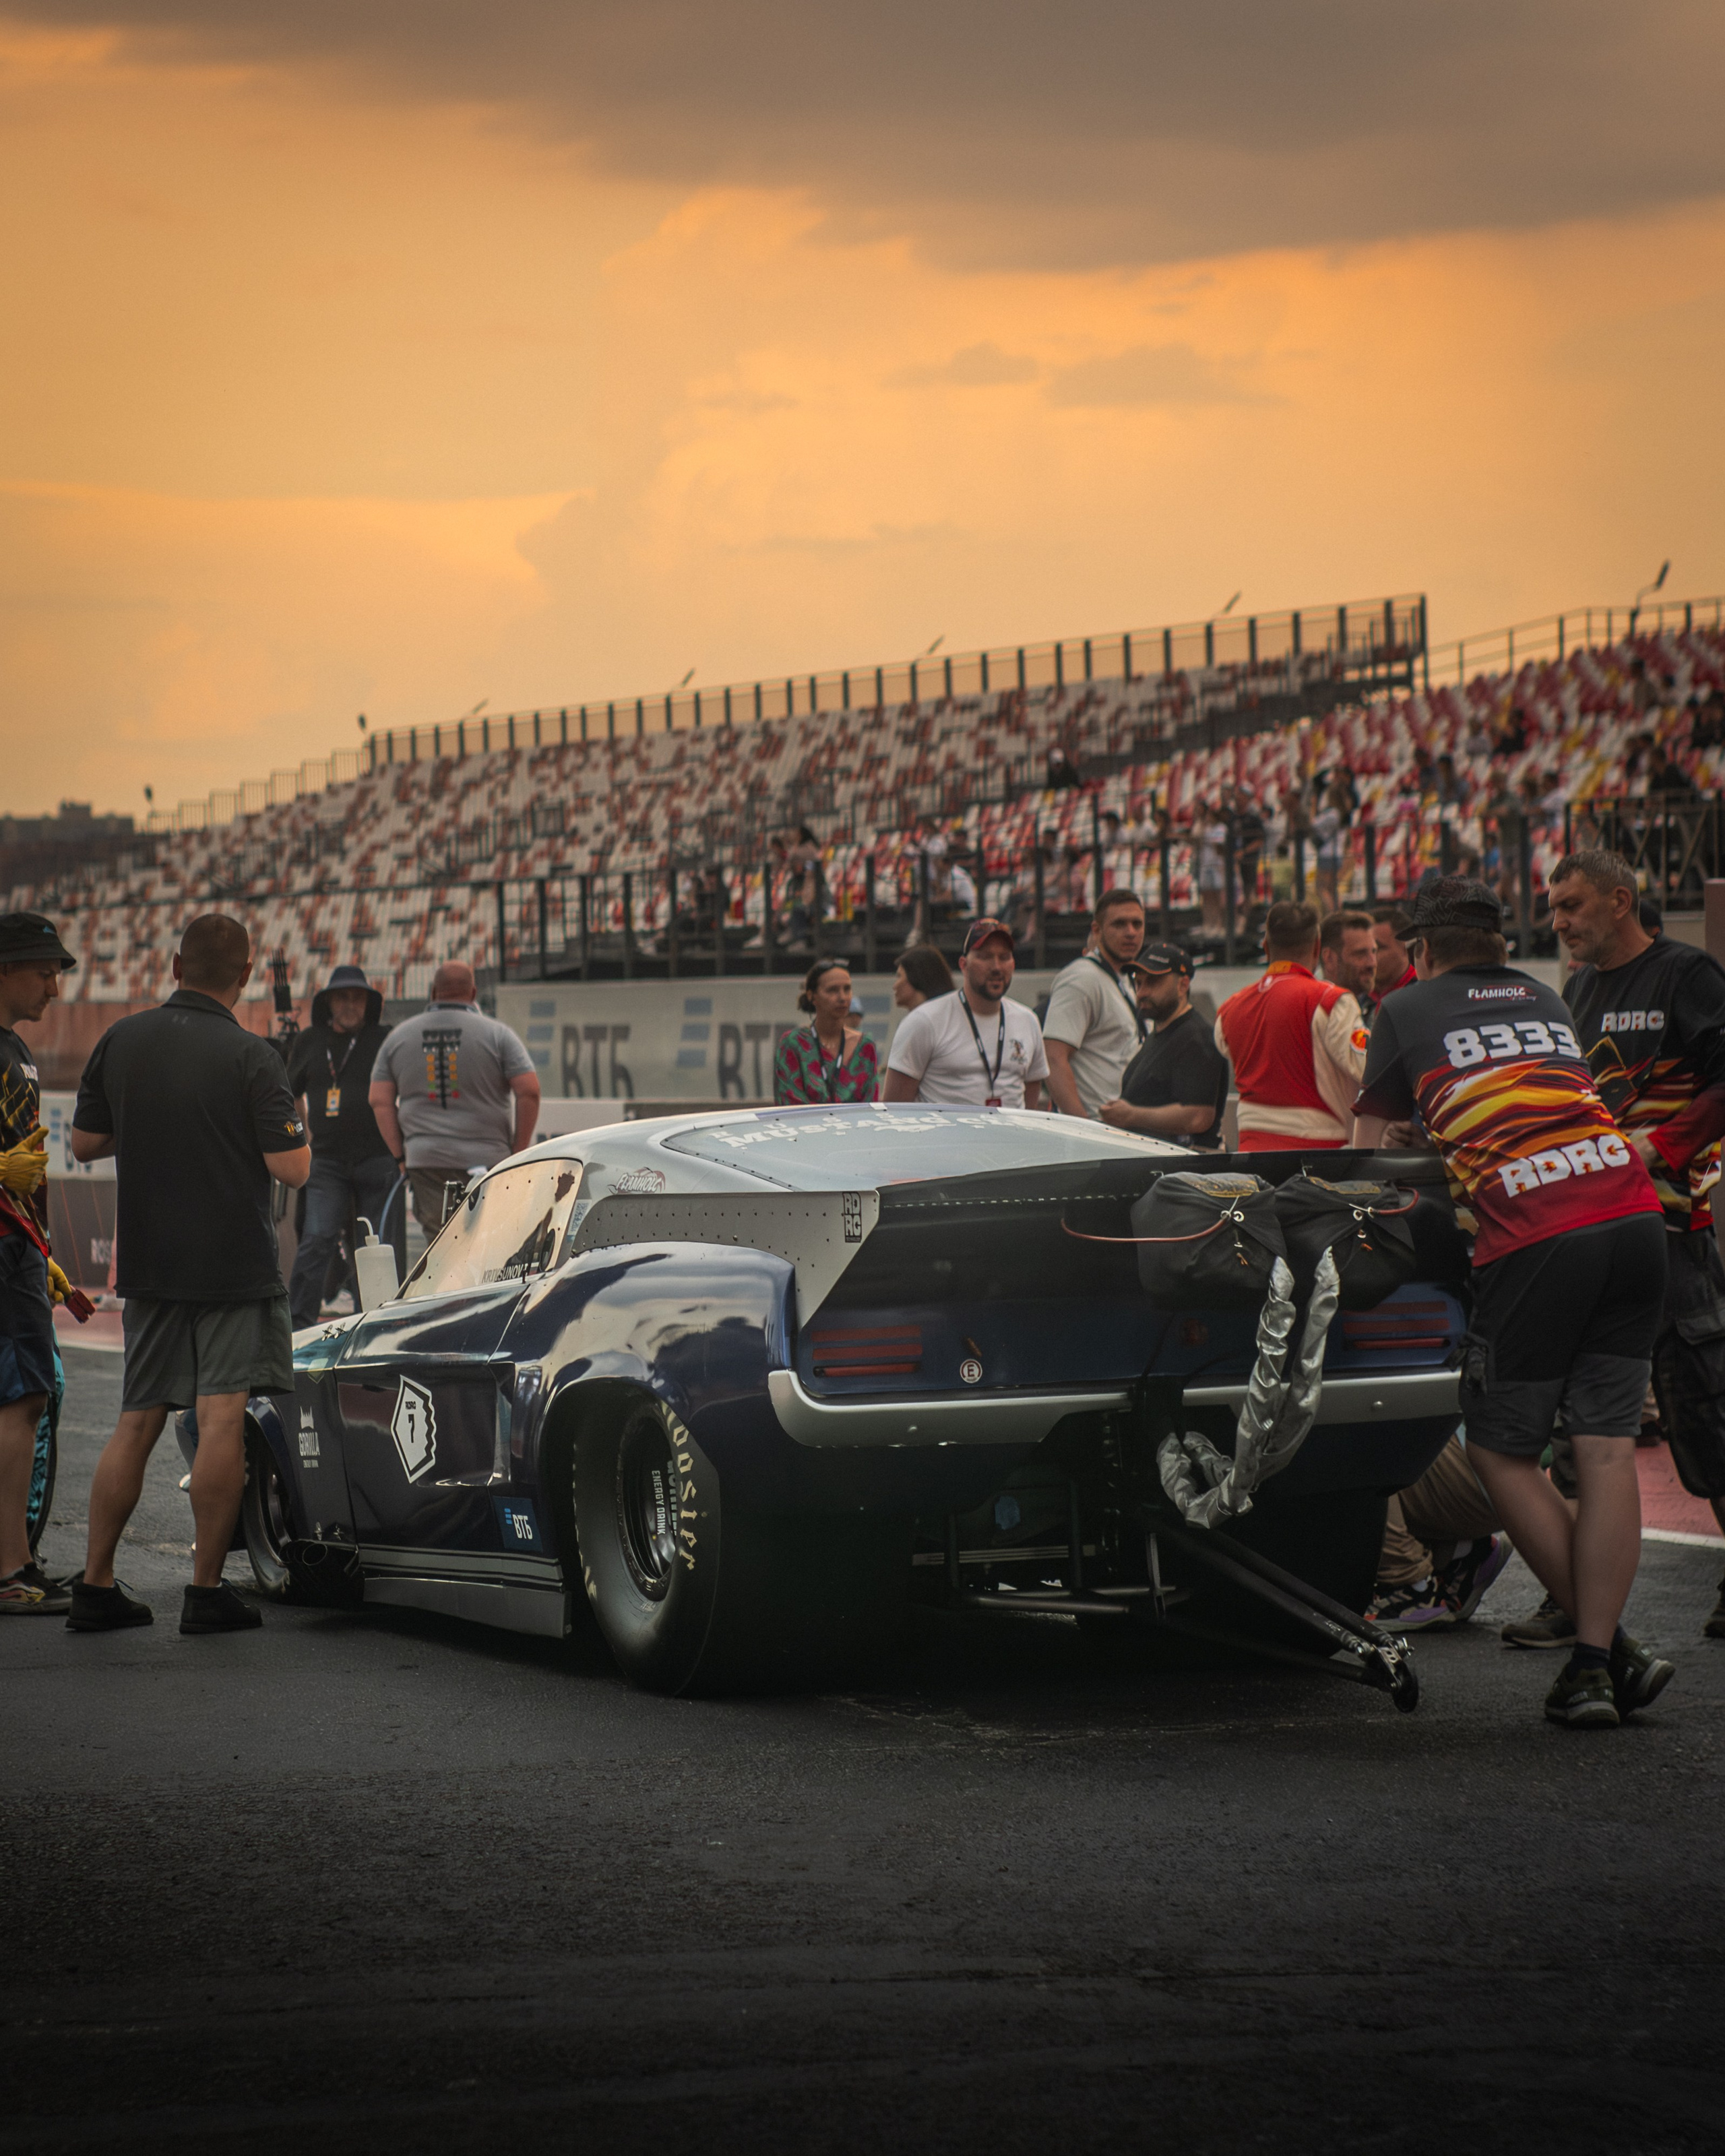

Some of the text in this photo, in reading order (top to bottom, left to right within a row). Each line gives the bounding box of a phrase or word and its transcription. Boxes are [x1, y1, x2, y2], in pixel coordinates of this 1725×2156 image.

[718, 1022, 798, 1100] ВТ
[1443, 1020, 1582, 1069] 8333
[1497, 1133, 1631, 1199] RDRC
[967, 1364, 975, 1377] E
[408, 1414, 414, 1443] 7
[512, 1513, 533, 1540] ВТБ
[652, 1470, 666, 1535] ENERGY DRINK
